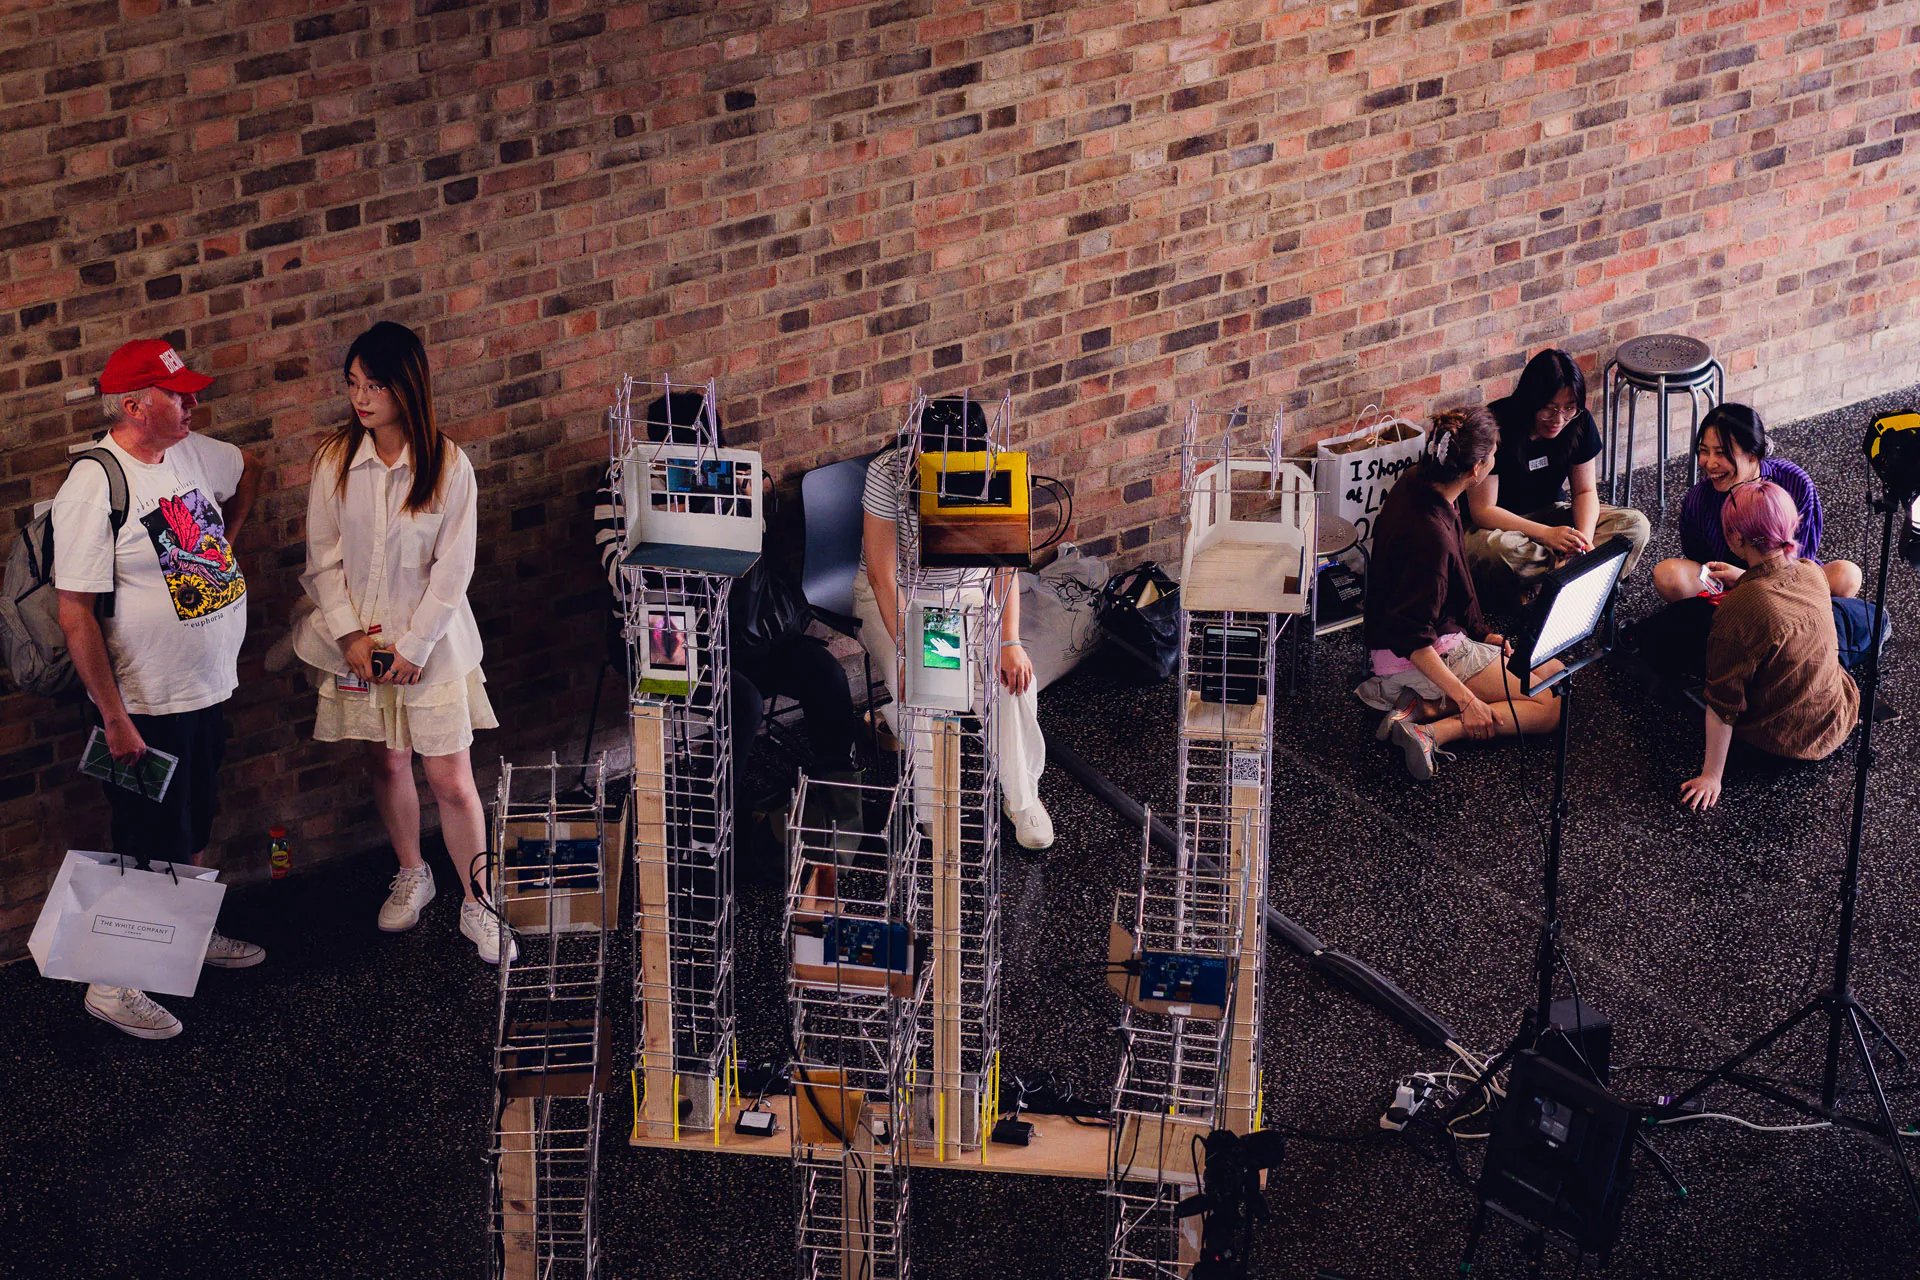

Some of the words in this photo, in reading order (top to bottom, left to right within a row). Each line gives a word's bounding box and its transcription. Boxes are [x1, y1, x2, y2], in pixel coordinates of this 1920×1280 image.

[1350, 460, 1363, 482] I
[1346, 486, 1364, 504] at
[100, 919, 113, 928] THE
[115, 921, 135, 931] WHITE
[137, 924, 169, 935] COMPANY
